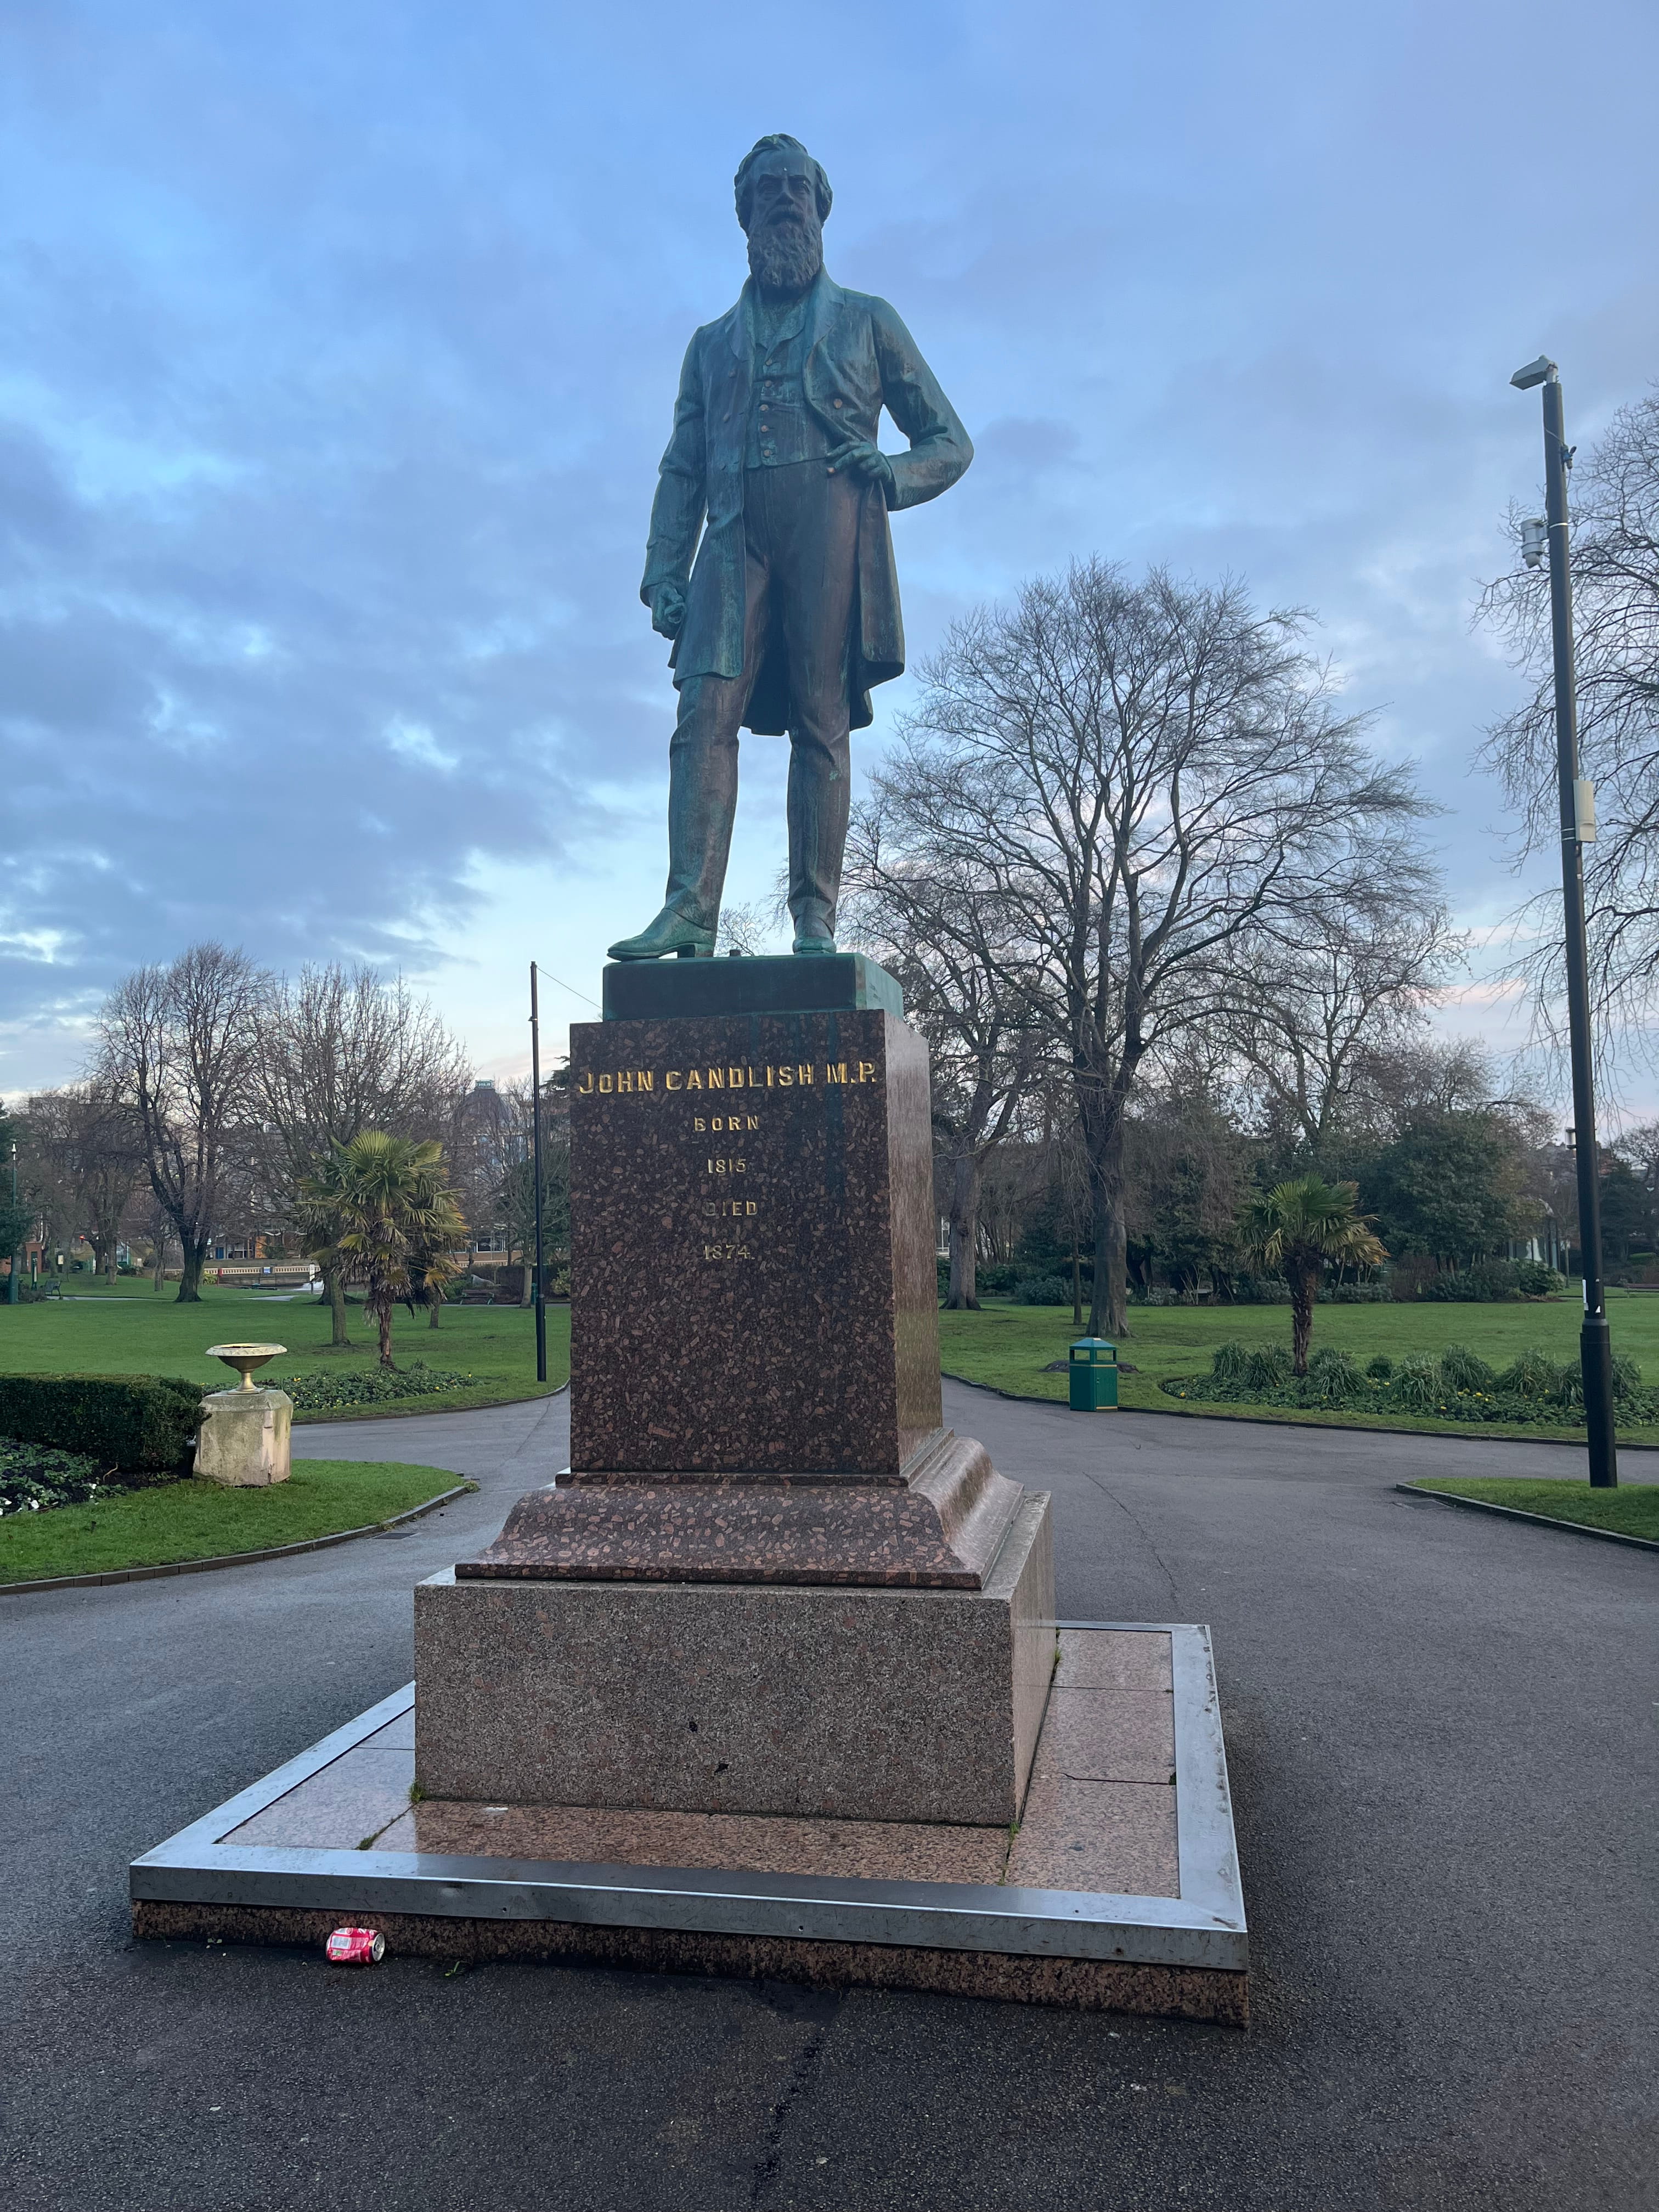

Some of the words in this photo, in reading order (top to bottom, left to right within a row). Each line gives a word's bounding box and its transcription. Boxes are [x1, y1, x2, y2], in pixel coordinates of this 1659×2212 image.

[579, 1070, 654, 1094] JOHN
[666, 1063, 814, 1091] CANDLISH
[827, 1061, 877, 1084] M.P.
[694, 1115, 759, 1131] BORN
[708, 1158, 747, 1173] 1815
[703, 1200, 758, 1216] DIED
